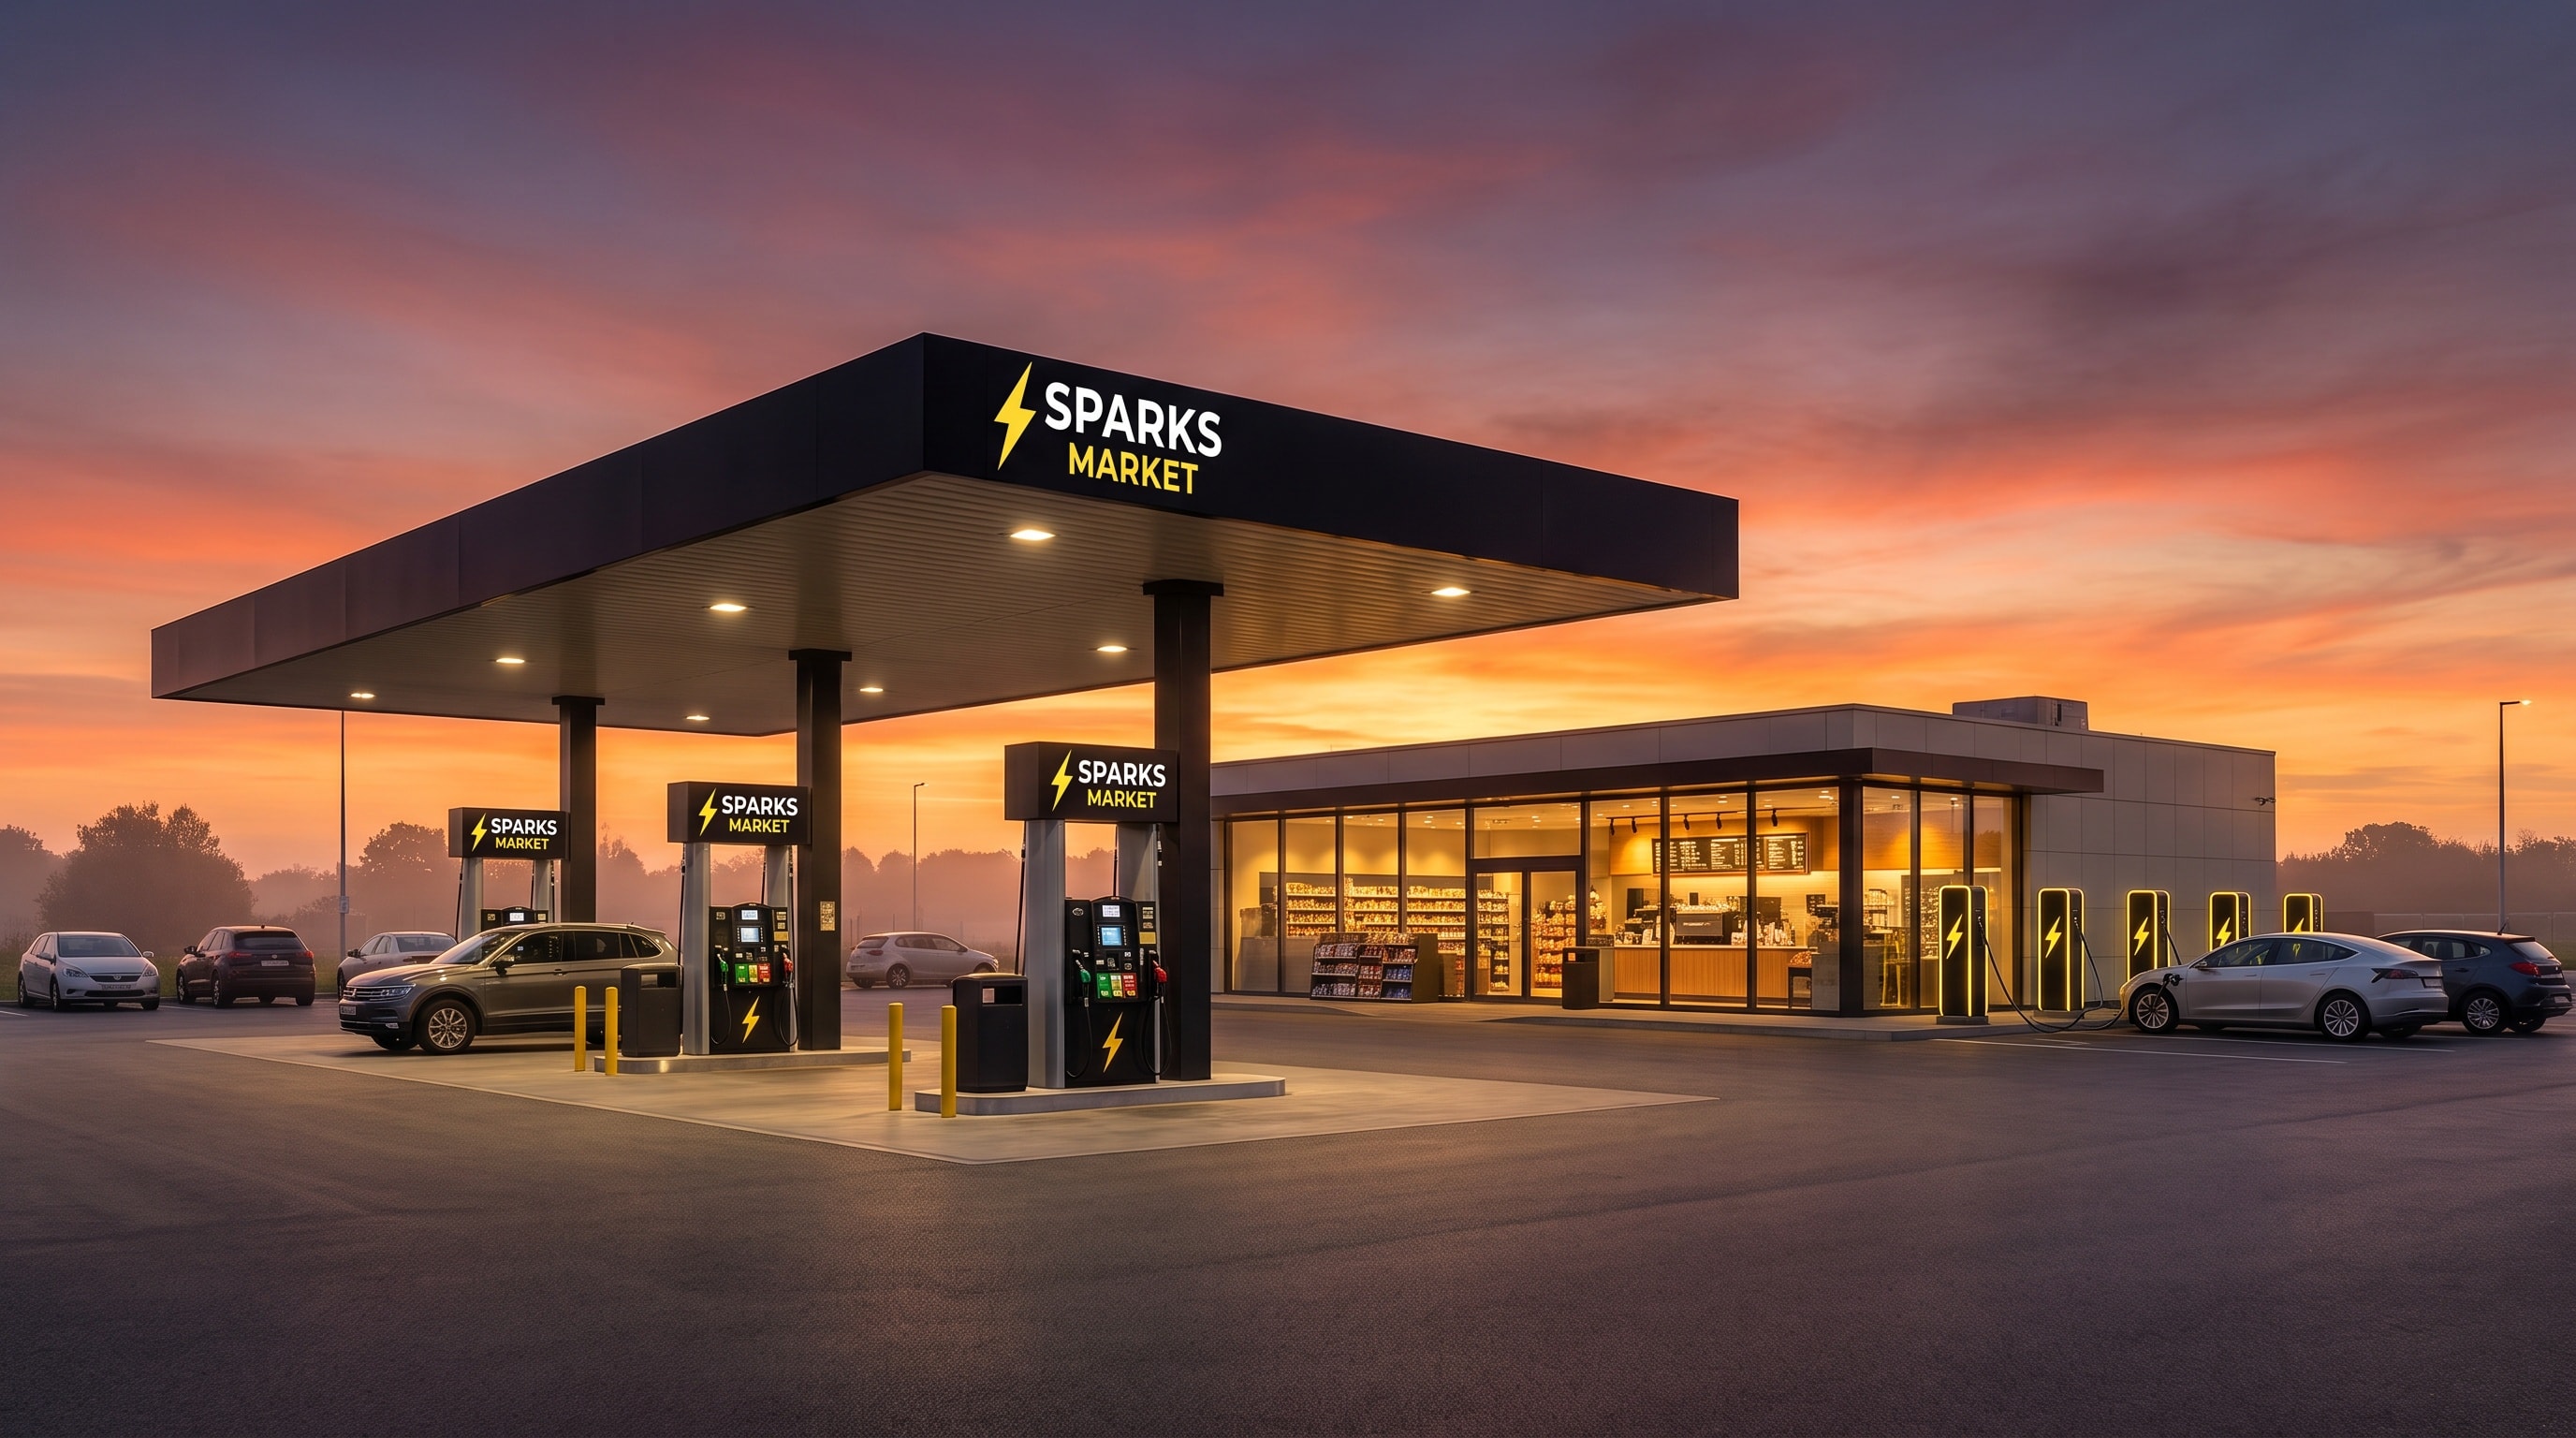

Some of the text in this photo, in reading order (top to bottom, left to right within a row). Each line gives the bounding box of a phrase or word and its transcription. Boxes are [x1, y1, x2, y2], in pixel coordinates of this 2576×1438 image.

[1045, 382, 1222, 458] SPARKS
[1069, 442, 1199, 494] MARKET
[1077, 759, 1166, 787] SPARKS
[722, 795, 798, 816] SPARKS
[1087, 789, 1157, 808] MARKET
[490, 817, 558, 836] SPARKS
[729, 817, 790, 832] MARKET
[495, 837, 549, 850] MARKET
